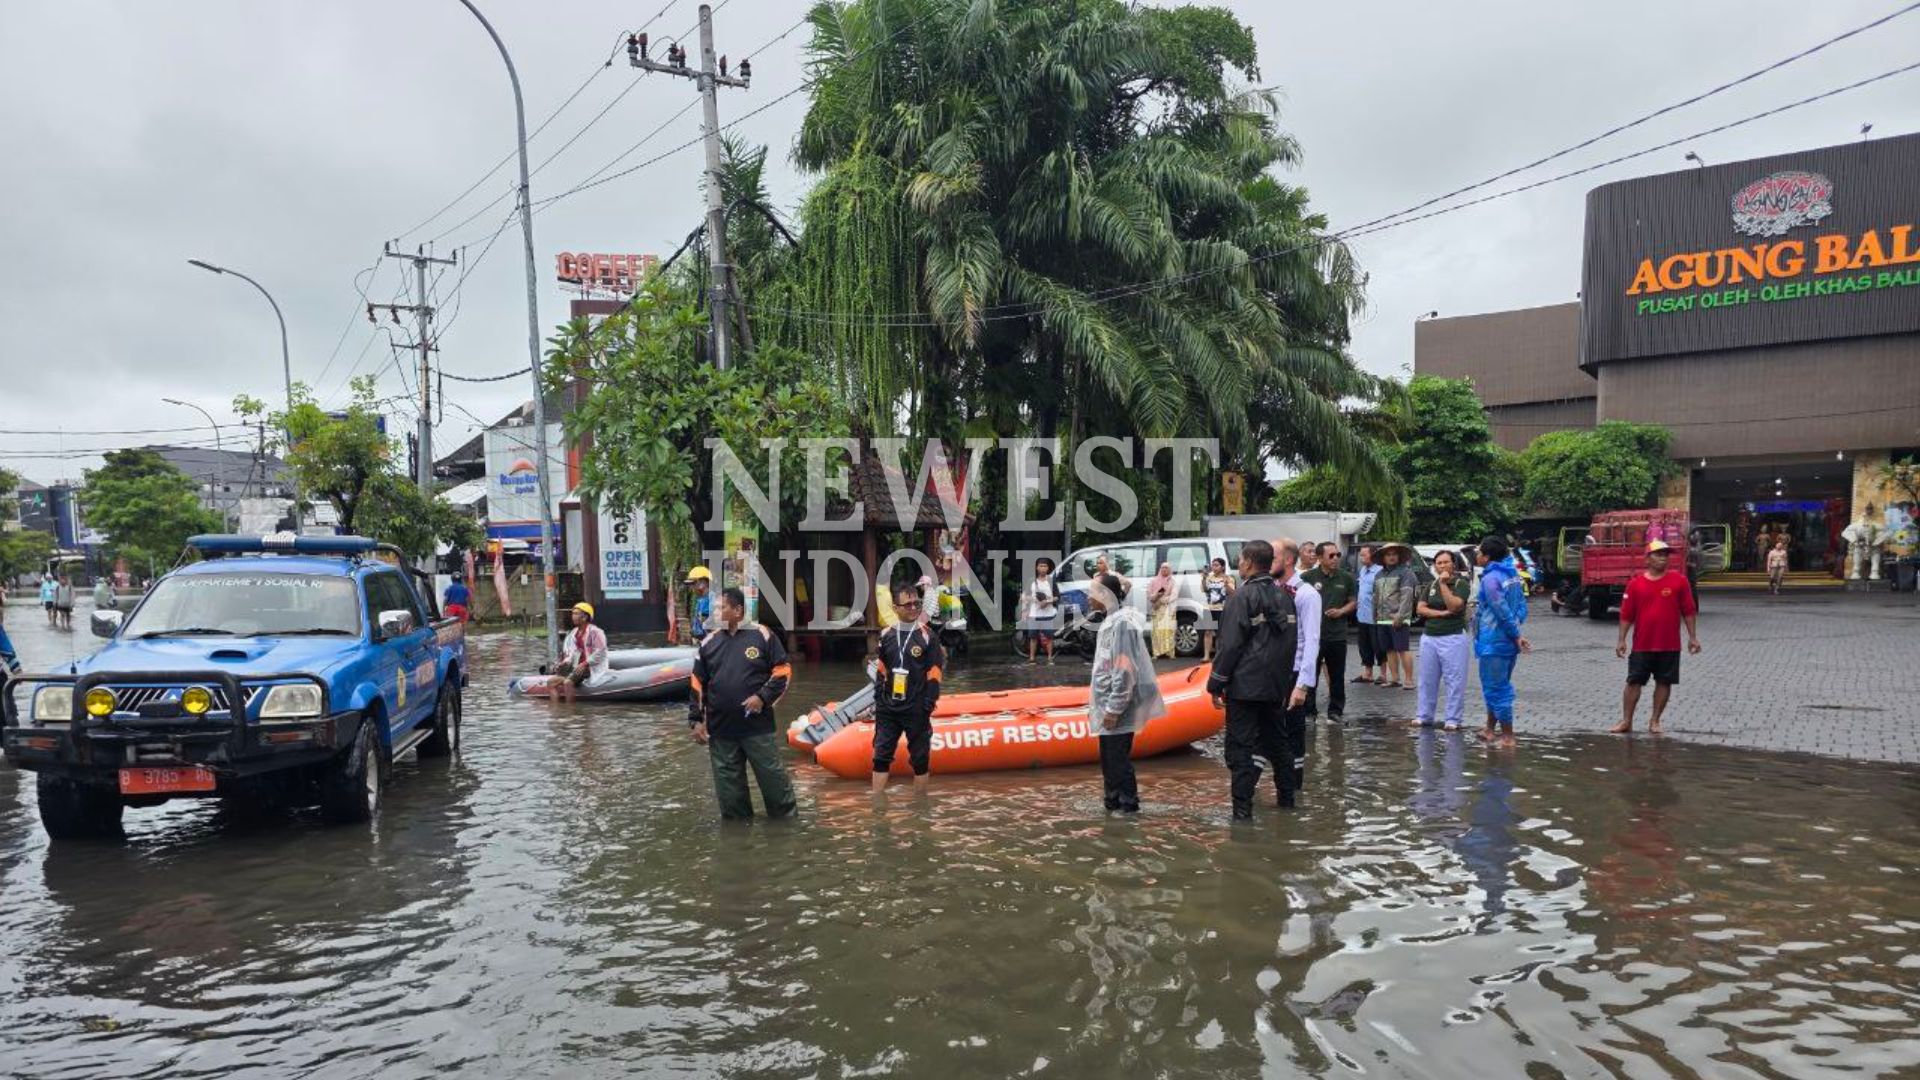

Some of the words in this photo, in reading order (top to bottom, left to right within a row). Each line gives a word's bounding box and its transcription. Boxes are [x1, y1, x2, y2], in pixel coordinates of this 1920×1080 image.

[1626, 240, 1806, 295] AGUNG
[1638, 295, 1696, 314] PUSAT
[1700, 288, 1750, 309] OLEH
[1761, 283, 1811, 302] OLEH
[1813, 275, 1873, 296] KHAS
[605, 551, 642, 562] OPEN
[606, 570, 642, 580] CLOSE
[930, 728, 995, 751] SURF
[121, 770, 131, 785] B
